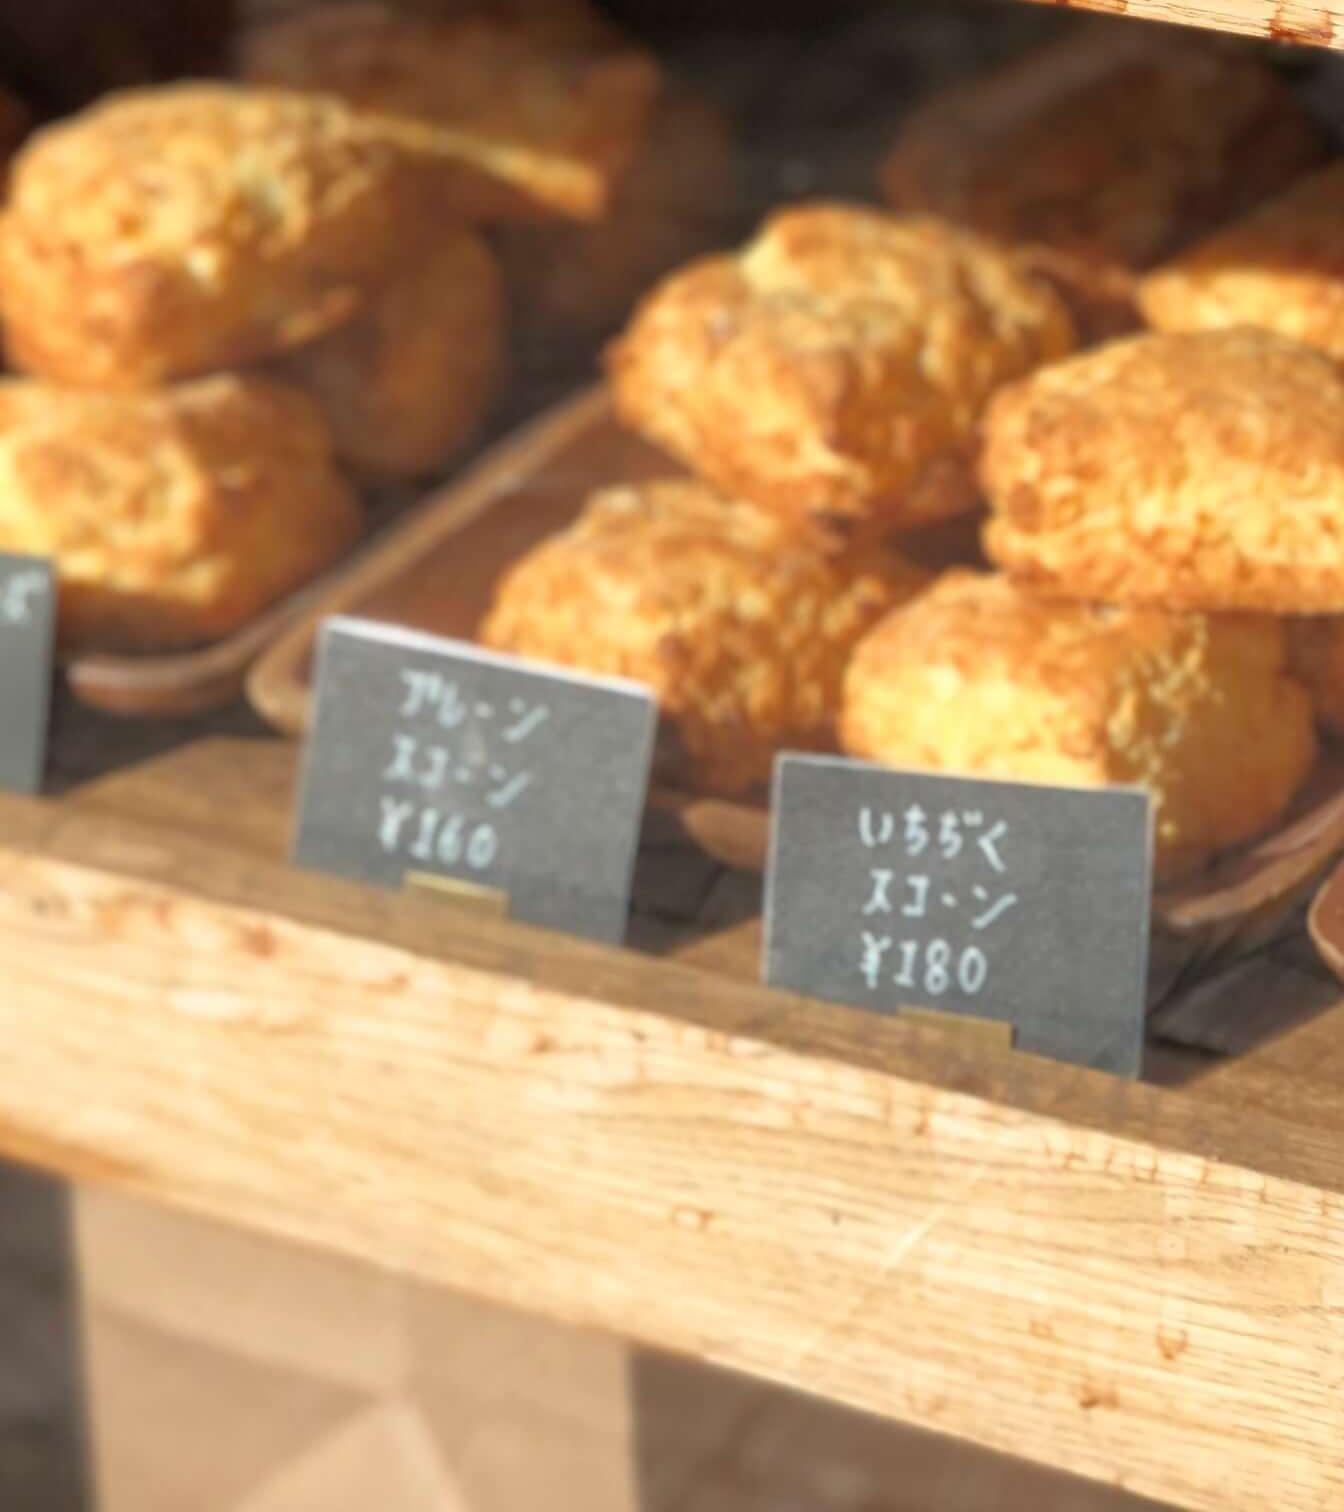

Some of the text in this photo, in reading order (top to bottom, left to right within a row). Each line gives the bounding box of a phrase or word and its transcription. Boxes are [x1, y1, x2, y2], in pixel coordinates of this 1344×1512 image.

[382, 733, 533, 808] スコーン
[376, 794, 497, 870] ¥160
[858, 802, 1008, 873] いちぢく
[862, 869, 1018, 929] スコーン
[860, 931, 987, 996] ¥180
